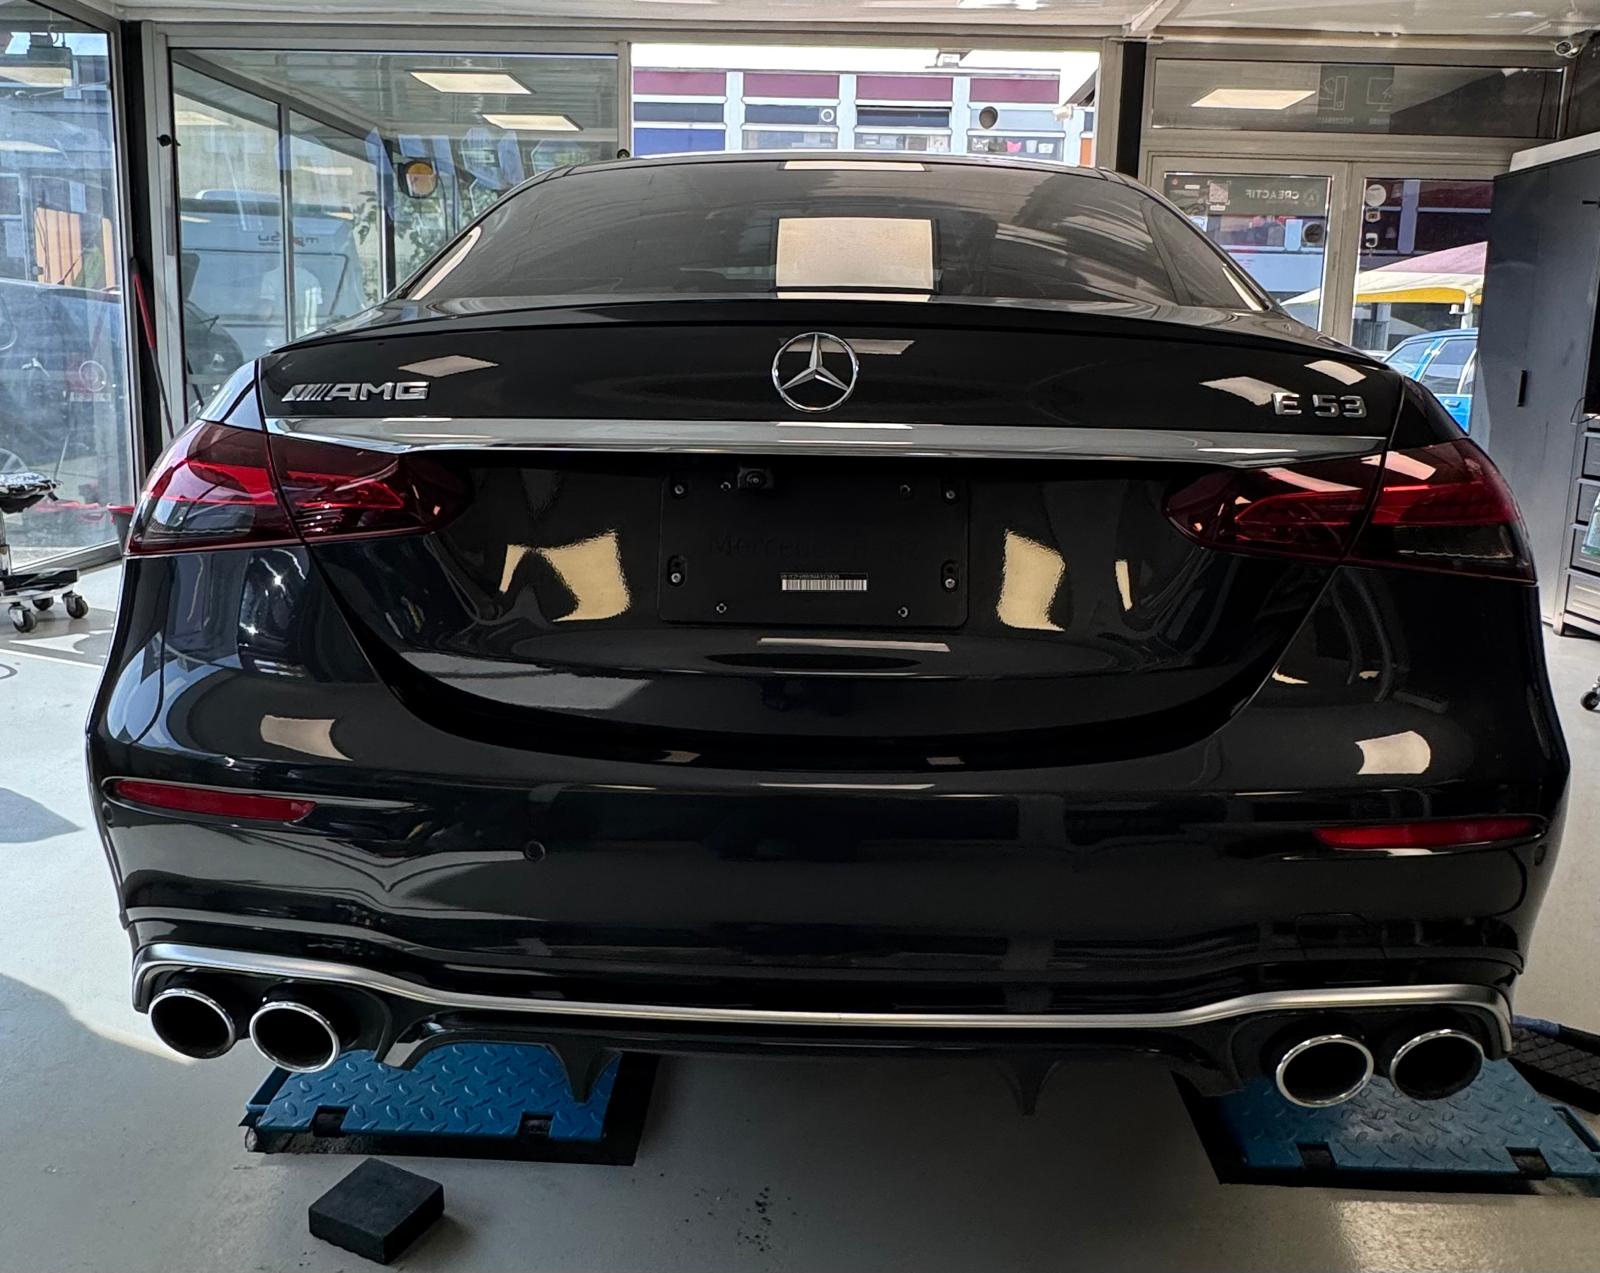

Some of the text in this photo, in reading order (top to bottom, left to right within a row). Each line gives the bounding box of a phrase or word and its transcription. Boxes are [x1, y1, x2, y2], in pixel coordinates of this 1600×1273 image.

[323, 381, 429, 401] AMG
[1272, 392, 1367, 418] E 53
